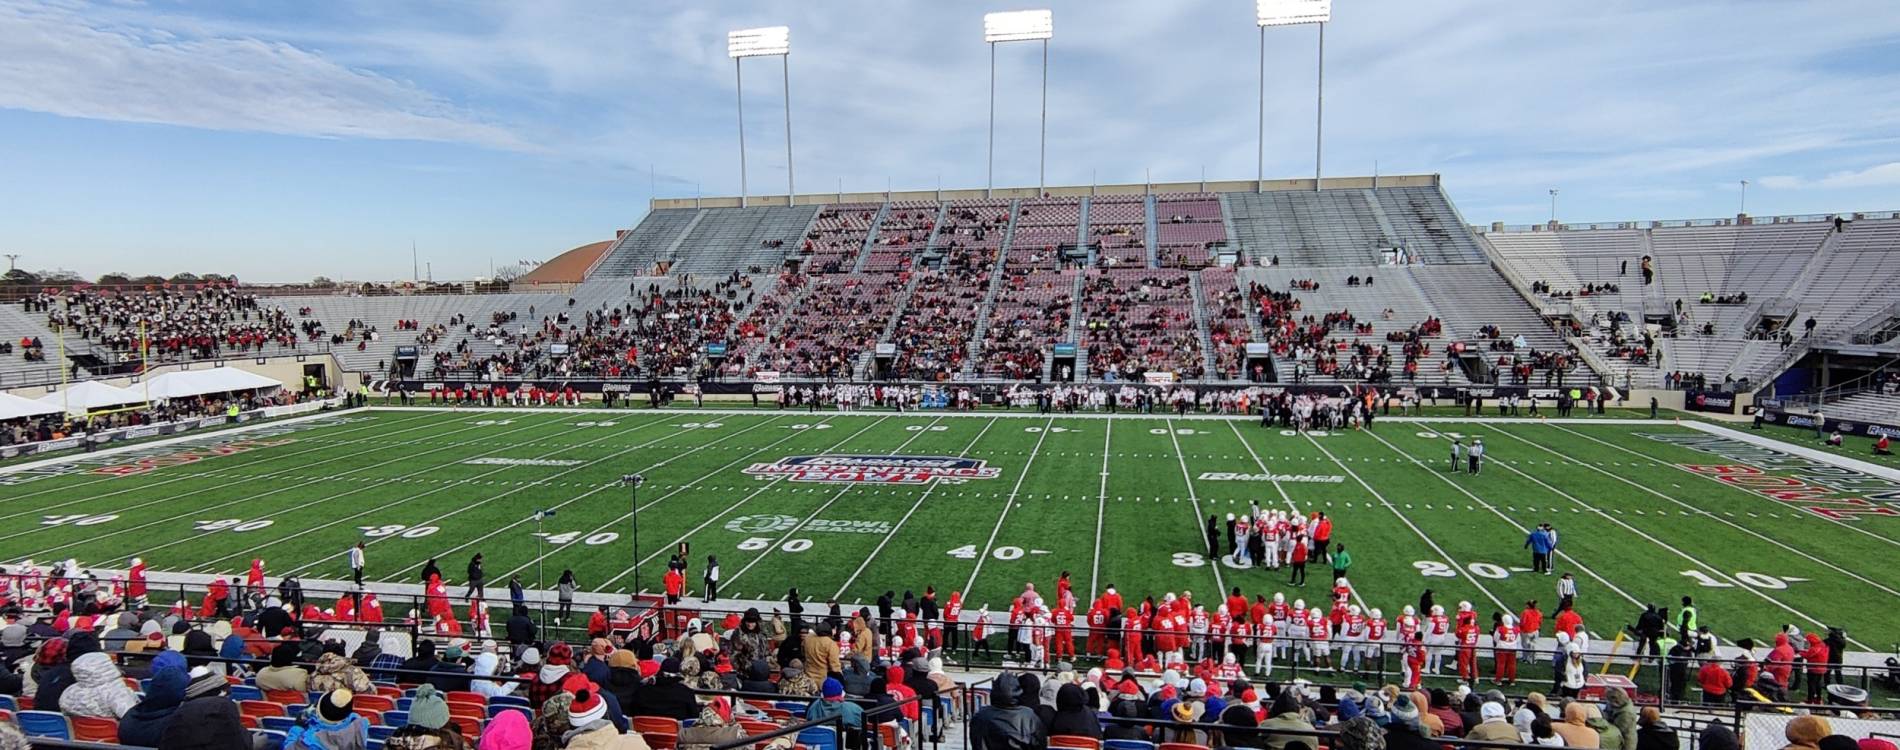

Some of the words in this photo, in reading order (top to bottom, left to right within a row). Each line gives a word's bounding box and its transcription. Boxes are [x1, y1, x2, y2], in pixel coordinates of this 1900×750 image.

[746, 463, 1002, 478] INDEPENDENCE
[802, 472, 928, 483] BOWL
[1198, 472, 1346, 483] RADIANCE
[801, 526, 892, 534] SEASON
[807, 518, 892, 528] BOWL
[363, 524, 441, 538] 30
[544, 531, 620, 545] 40
[736, 537, 814, 552] 50
[946, 544, 1025, 560] 40
[1412, 560, 1510, 579] 20
[1680, 569, 1788, 590] 10
